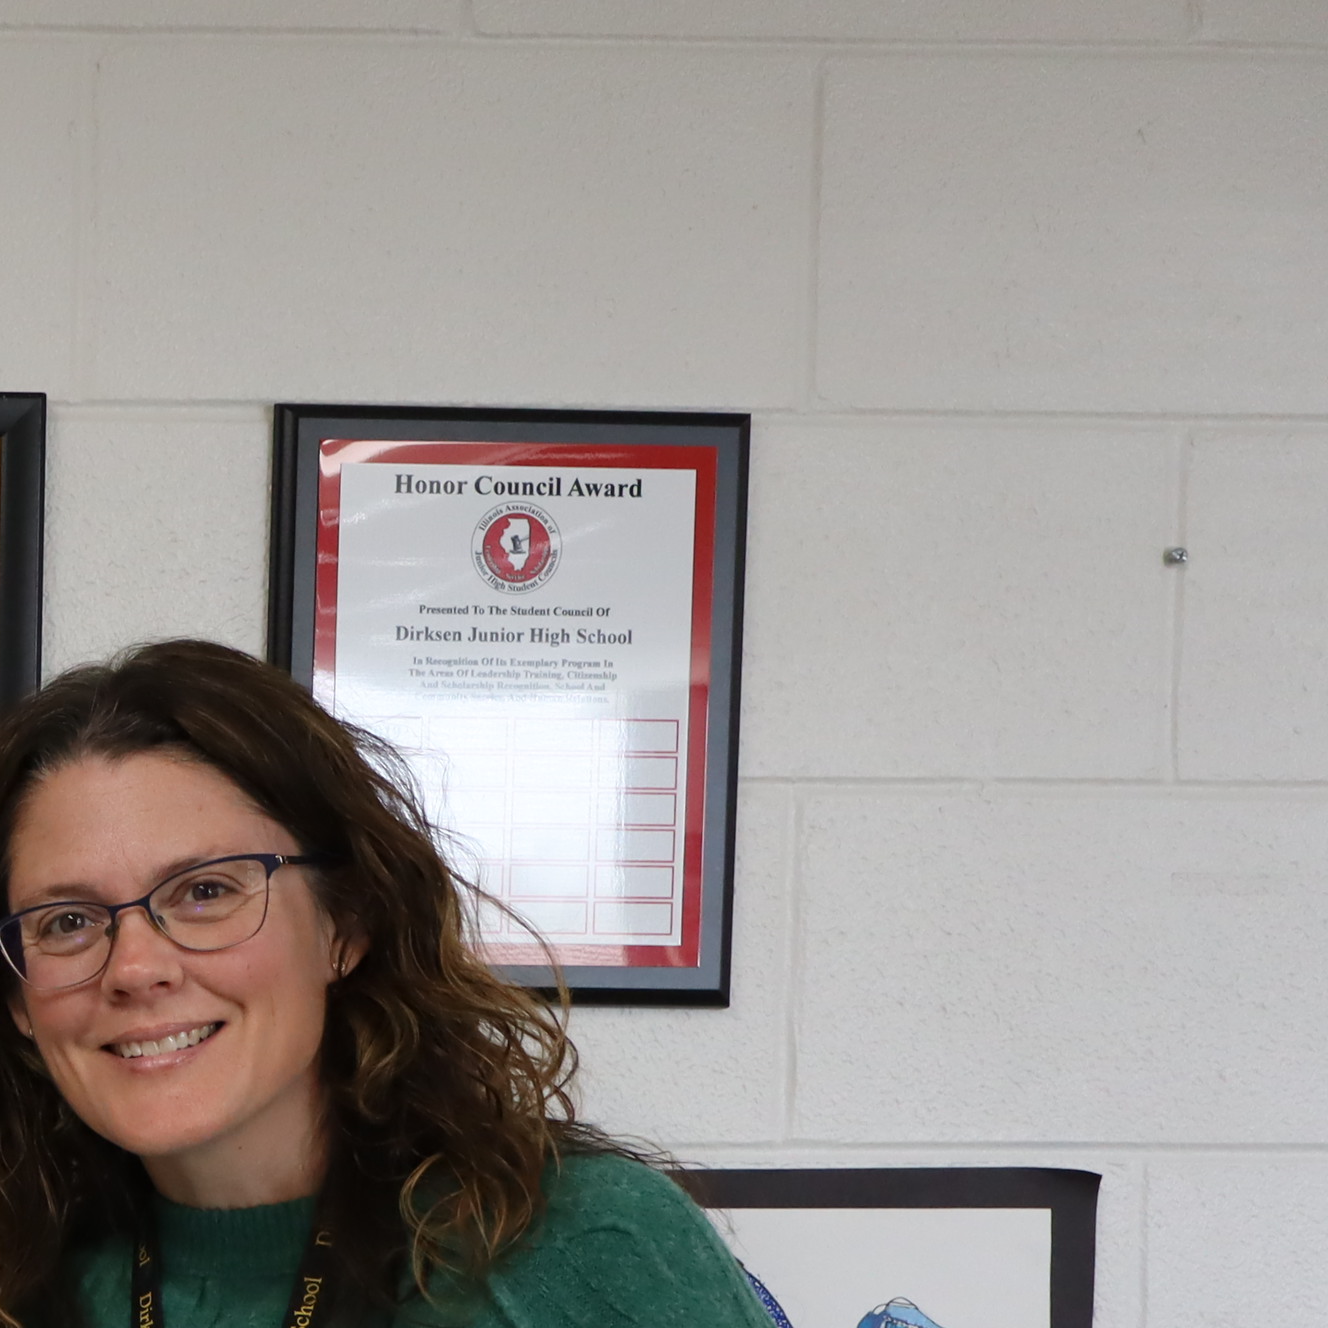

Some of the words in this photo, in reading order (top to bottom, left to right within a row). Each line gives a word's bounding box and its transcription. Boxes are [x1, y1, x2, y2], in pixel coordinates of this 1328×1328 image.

[395, 474, 468, 495] Honor
[474, 475, 562, 497] Council
[567, 477, 642, 498] Award
[419, 604, 469, 615] Presented
[471, 604, 485, 615] To
[487, 605, 508, 616] The
[510, 605, 550, 616] Student
[552, 606, 593, 617] Council
[595, 607, 611, 617] Of
[395, 625, 462, 642] Dirksen
[467, 626, 525, 643] Junior
[529, 627, 570, 647] High
[576, 628, 632, 645] School
